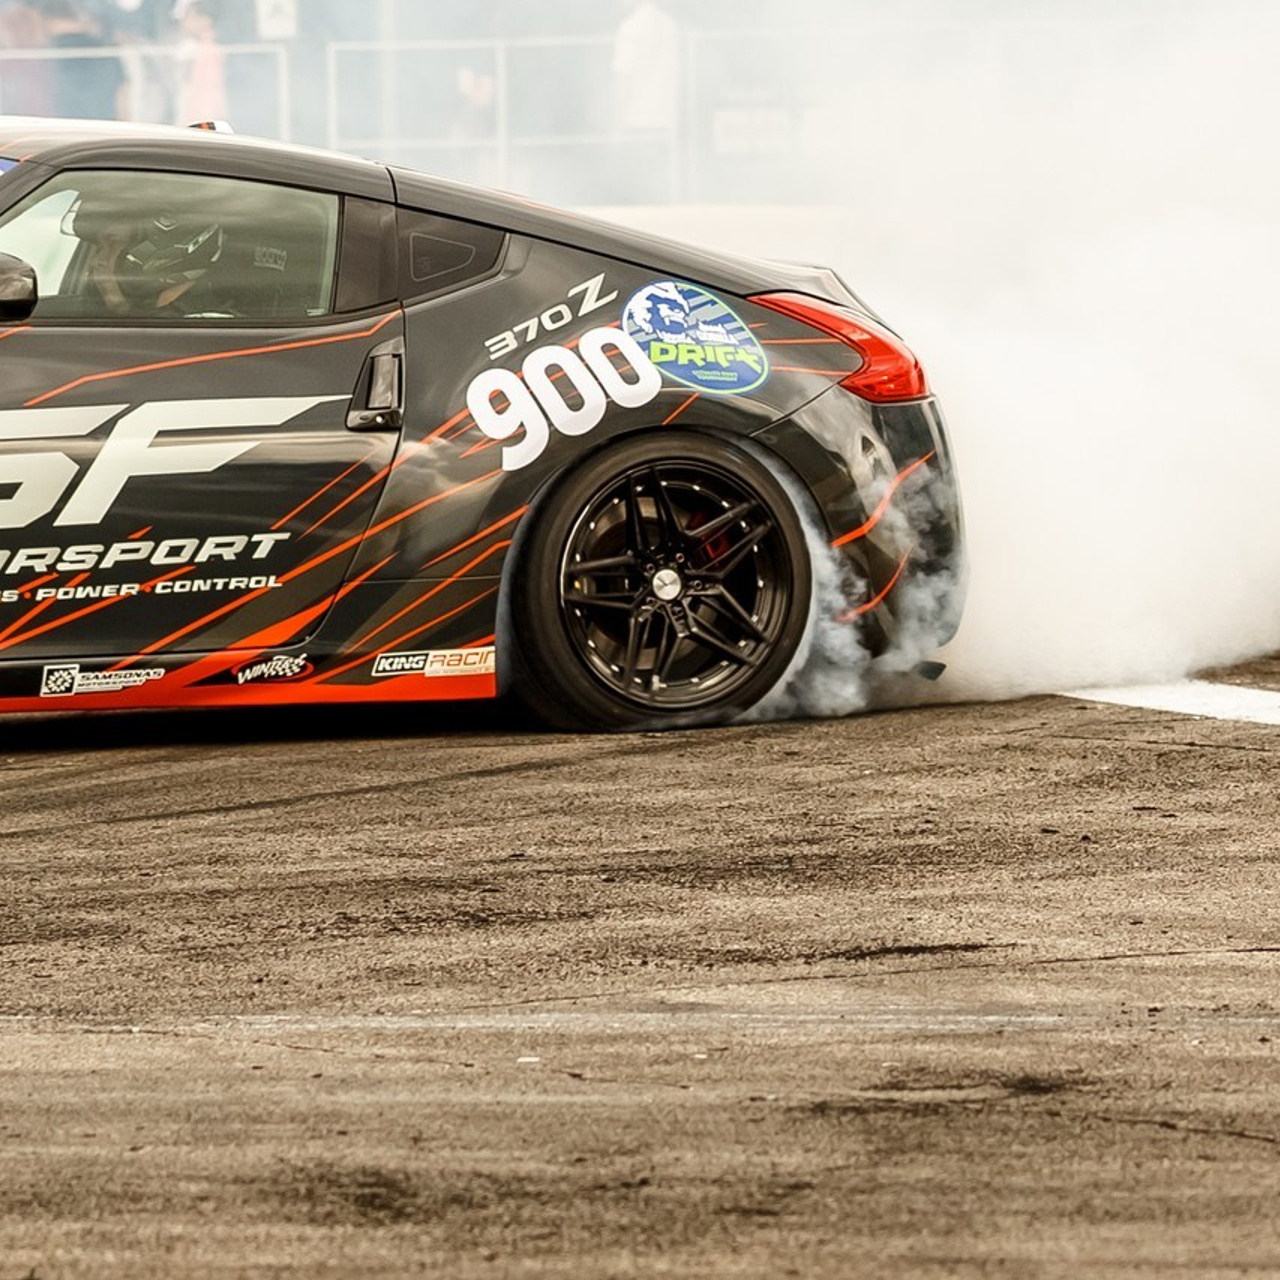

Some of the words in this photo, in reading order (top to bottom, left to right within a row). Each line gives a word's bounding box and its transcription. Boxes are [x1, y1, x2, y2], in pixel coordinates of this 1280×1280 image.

[483, 273, 619, 360] 370Z
[650, 341, 763, 374] DRIFT
[466, 326, 662, 471] 900
[35, 583, 141, 602] POWER
[154, 575, 284, 594] CONTROL
[80, 670, 162, 681] SAMSONAS
[377, 655, 426, 671] KING
